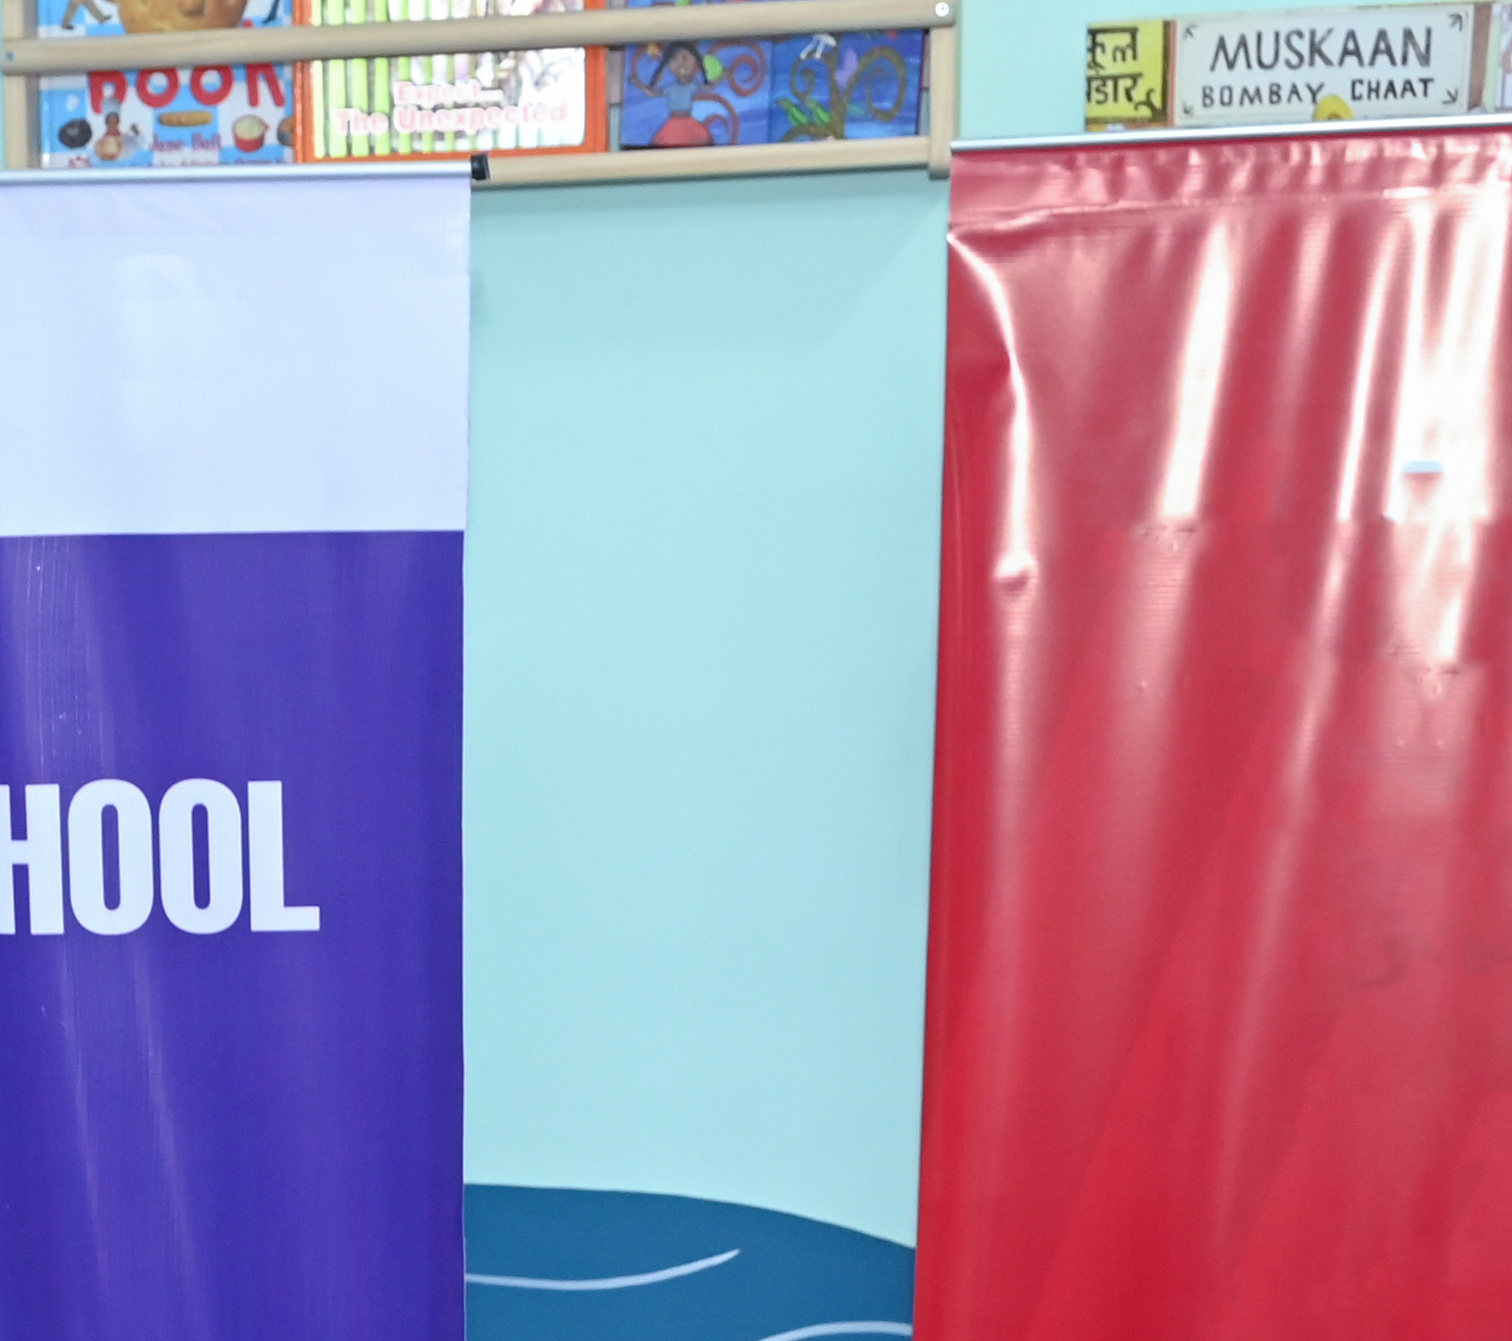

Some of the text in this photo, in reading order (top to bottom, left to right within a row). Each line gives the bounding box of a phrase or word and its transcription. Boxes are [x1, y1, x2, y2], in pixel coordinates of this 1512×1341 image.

[1209, 27, 1432, 72] MUSKAAN
[1201, 78, 1434, 108] BOMBAY CHAAT
[336, 102, 567, 133] The Unexpected
